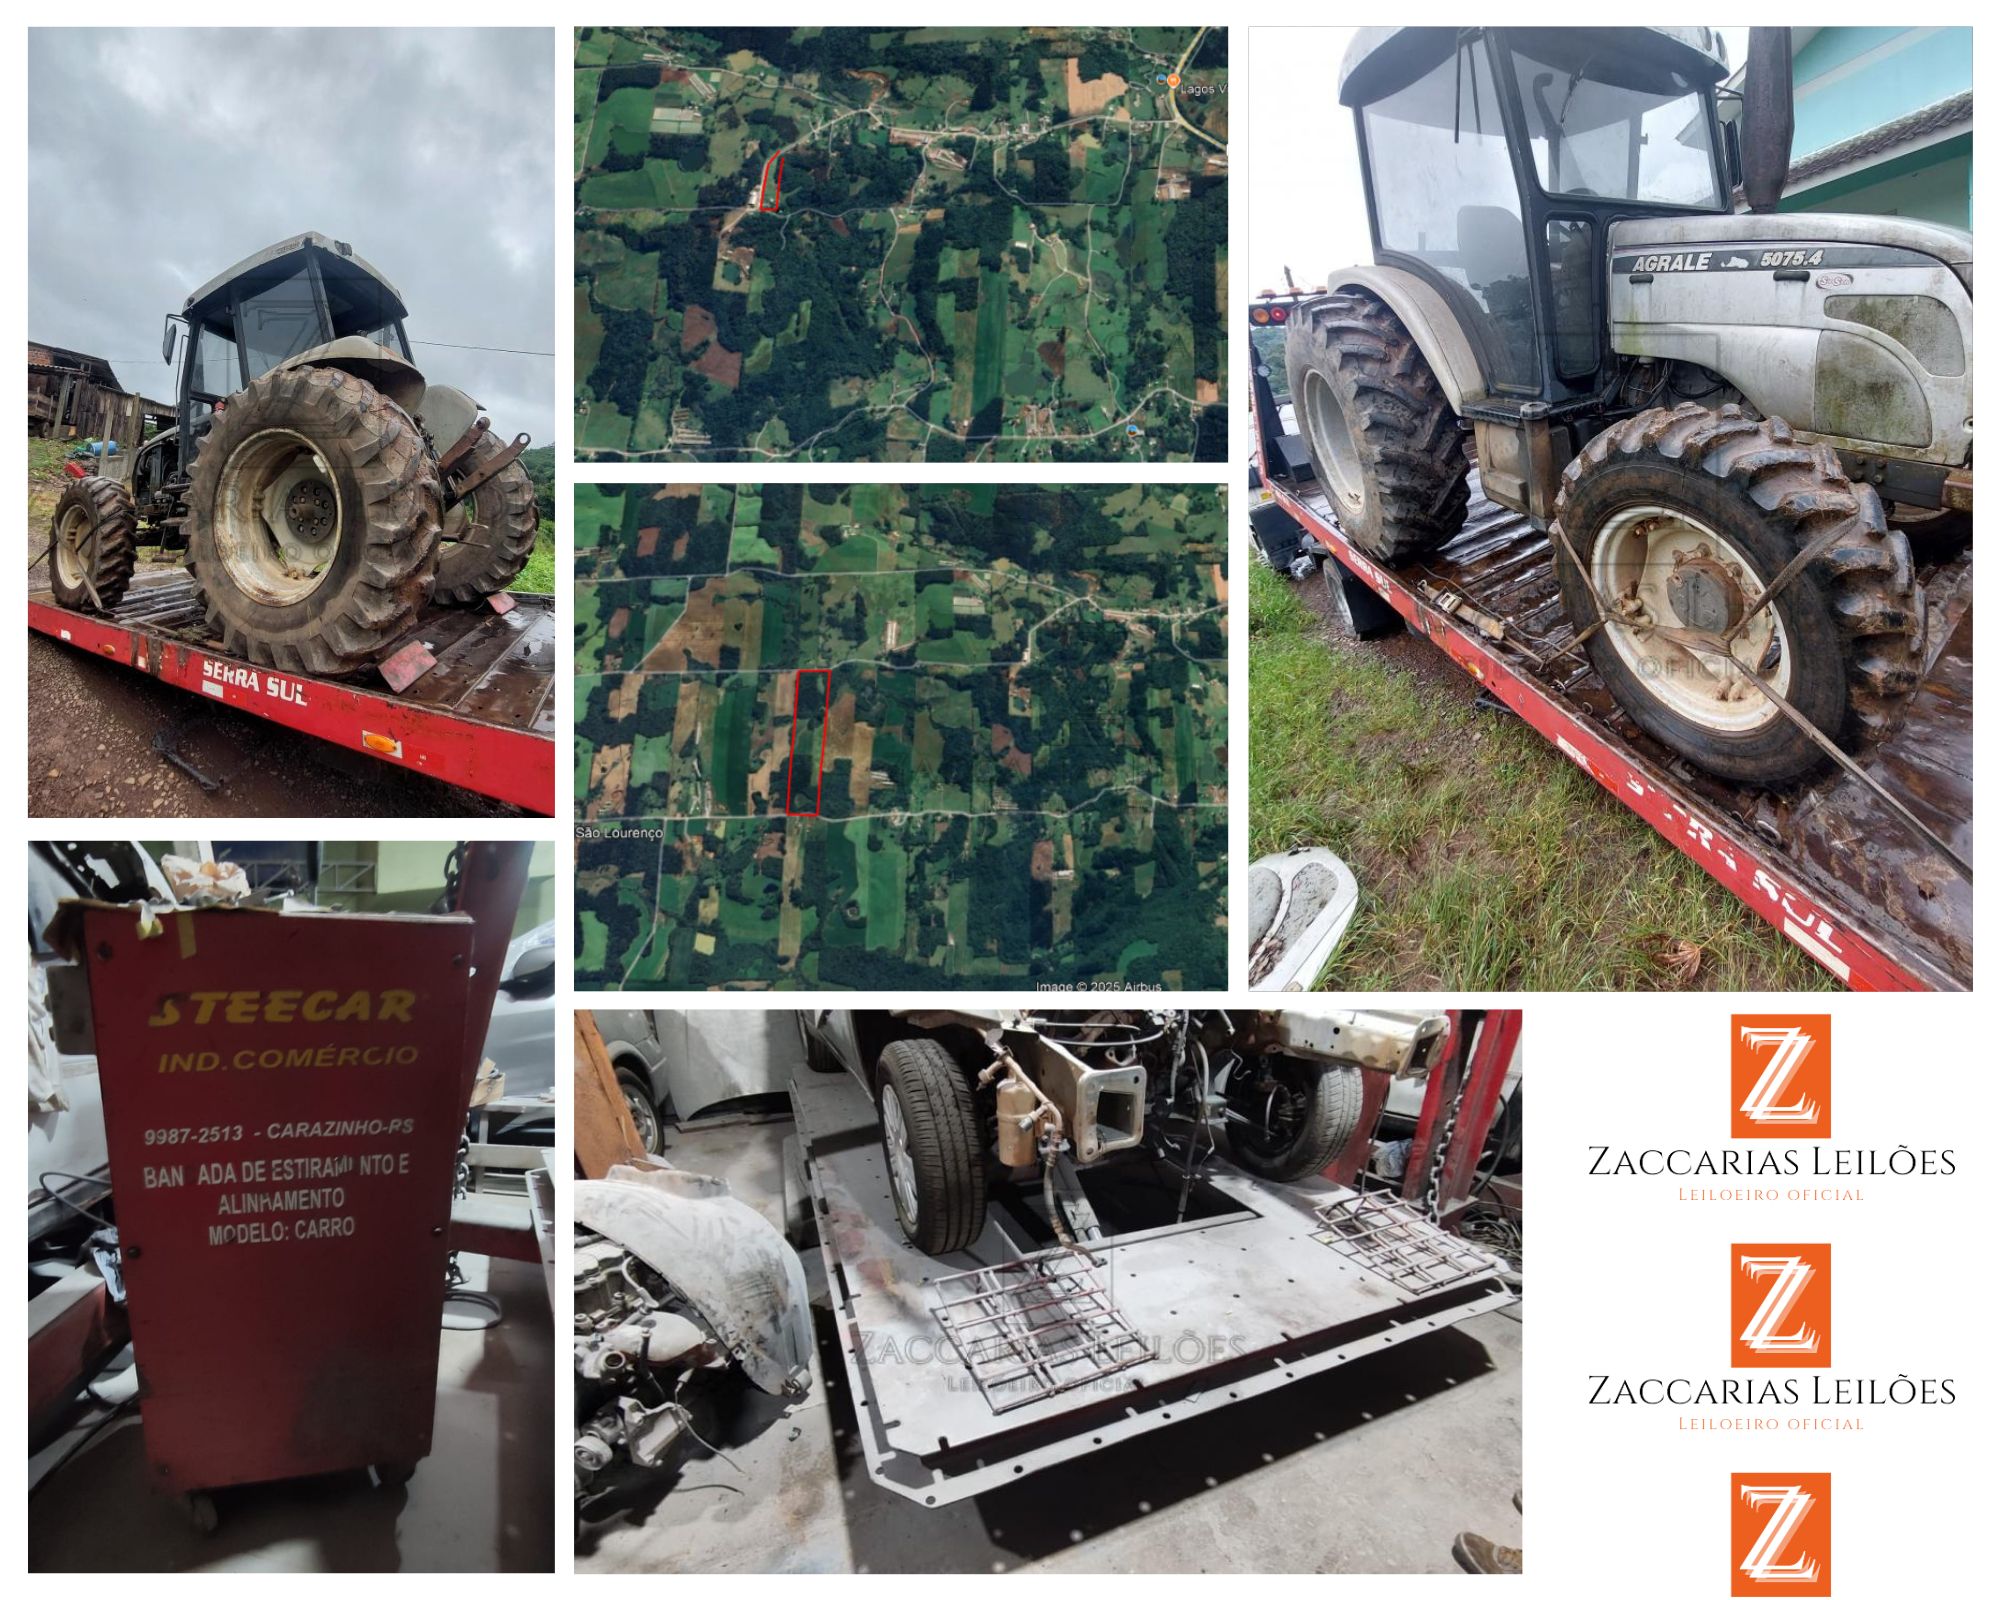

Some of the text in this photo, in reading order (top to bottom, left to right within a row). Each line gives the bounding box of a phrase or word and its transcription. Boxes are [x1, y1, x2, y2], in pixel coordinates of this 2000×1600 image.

[1632, 250, 1825, 272] AGRALE 5075.4
[203, 660, 308, 707] SERRA SUL
[148, 988, 417, 1027] STEECAR
[144, 1124, 243, 1146] 9987-2513
[143, 1161, 237, 1189] BANADA
[242, 1159, 266, 1183] DE
[399, 1152, 410, 1174] E
[218, 1187, 345, 1215] ALINHAMENTO
[208, 1216, 355, 1246] MODELO: CARRO
